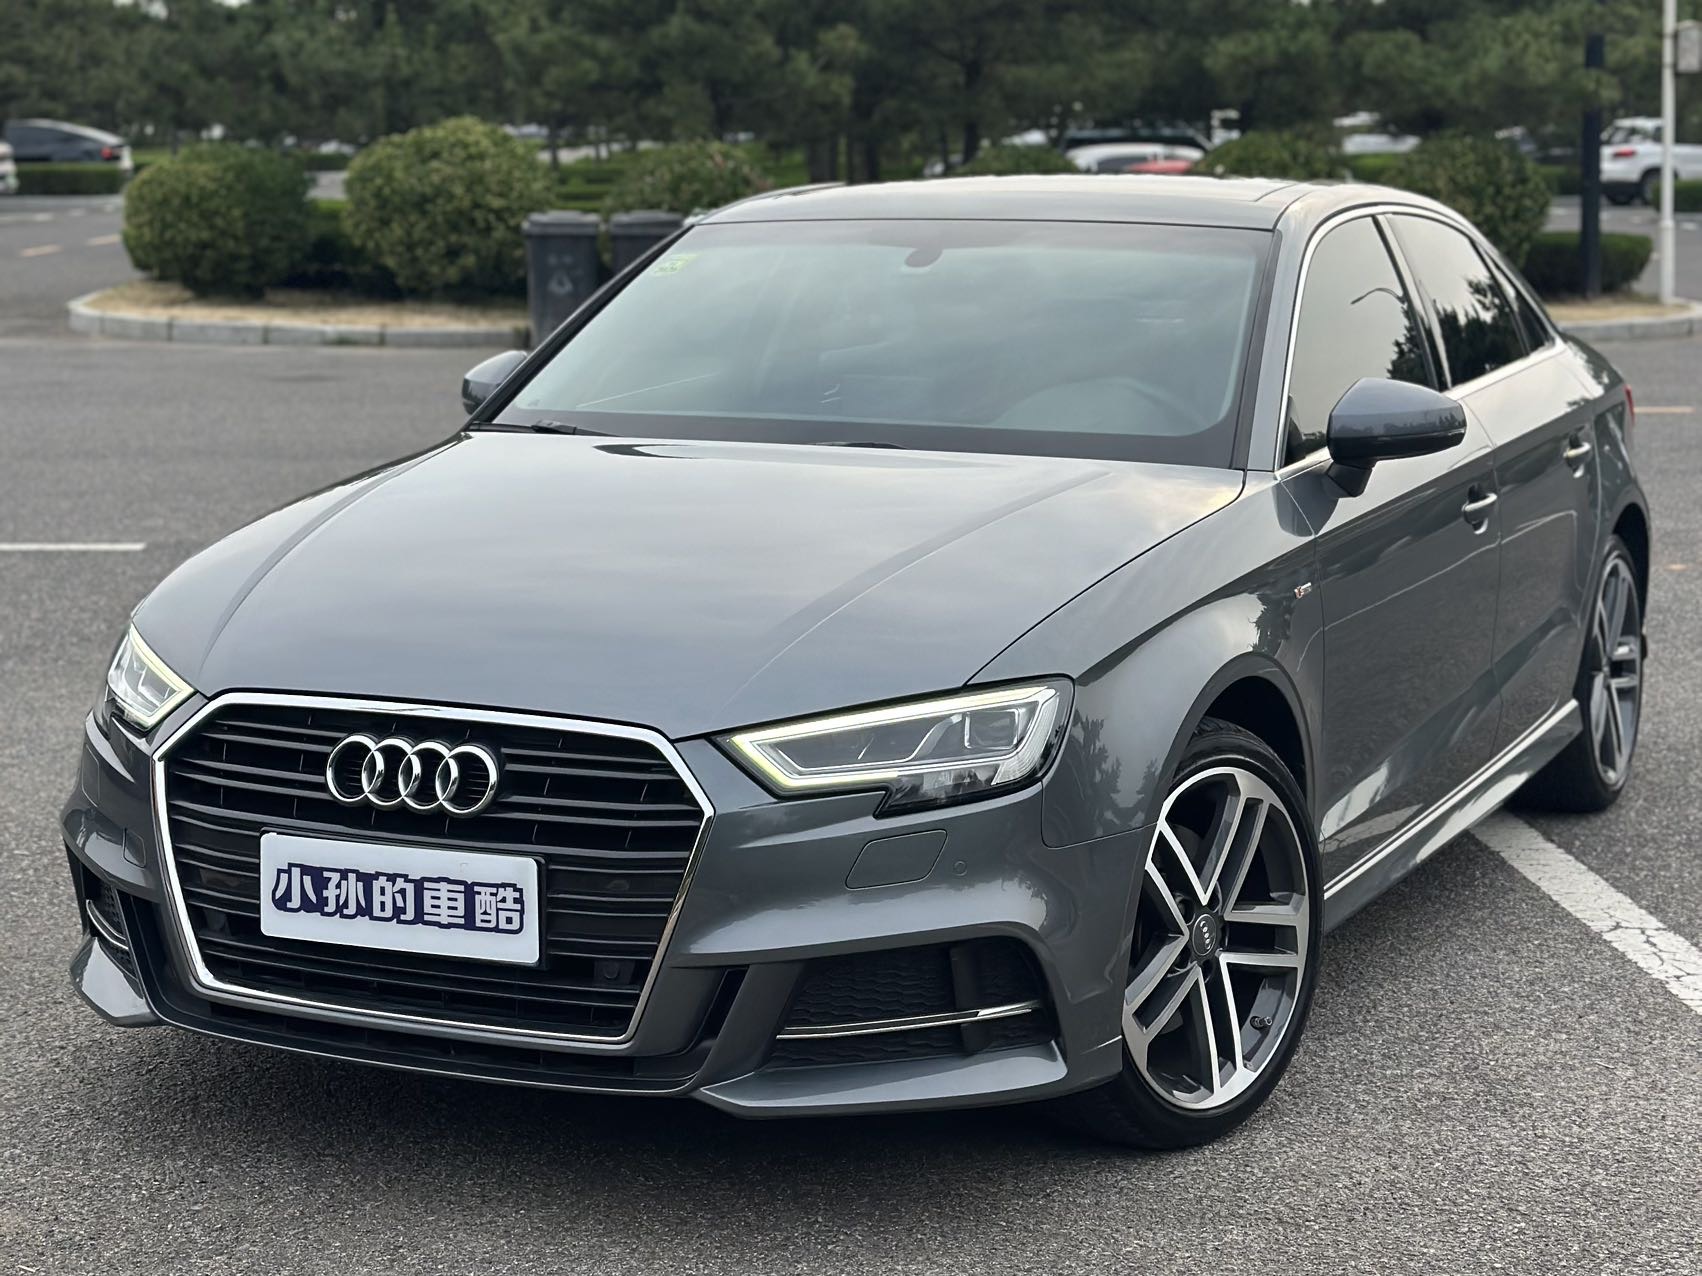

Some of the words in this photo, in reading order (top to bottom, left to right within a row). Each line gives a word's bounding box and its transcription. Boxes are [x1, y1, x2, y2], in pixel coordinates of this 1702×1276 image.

[273, 865, 523, 931] 小孙的車酷
